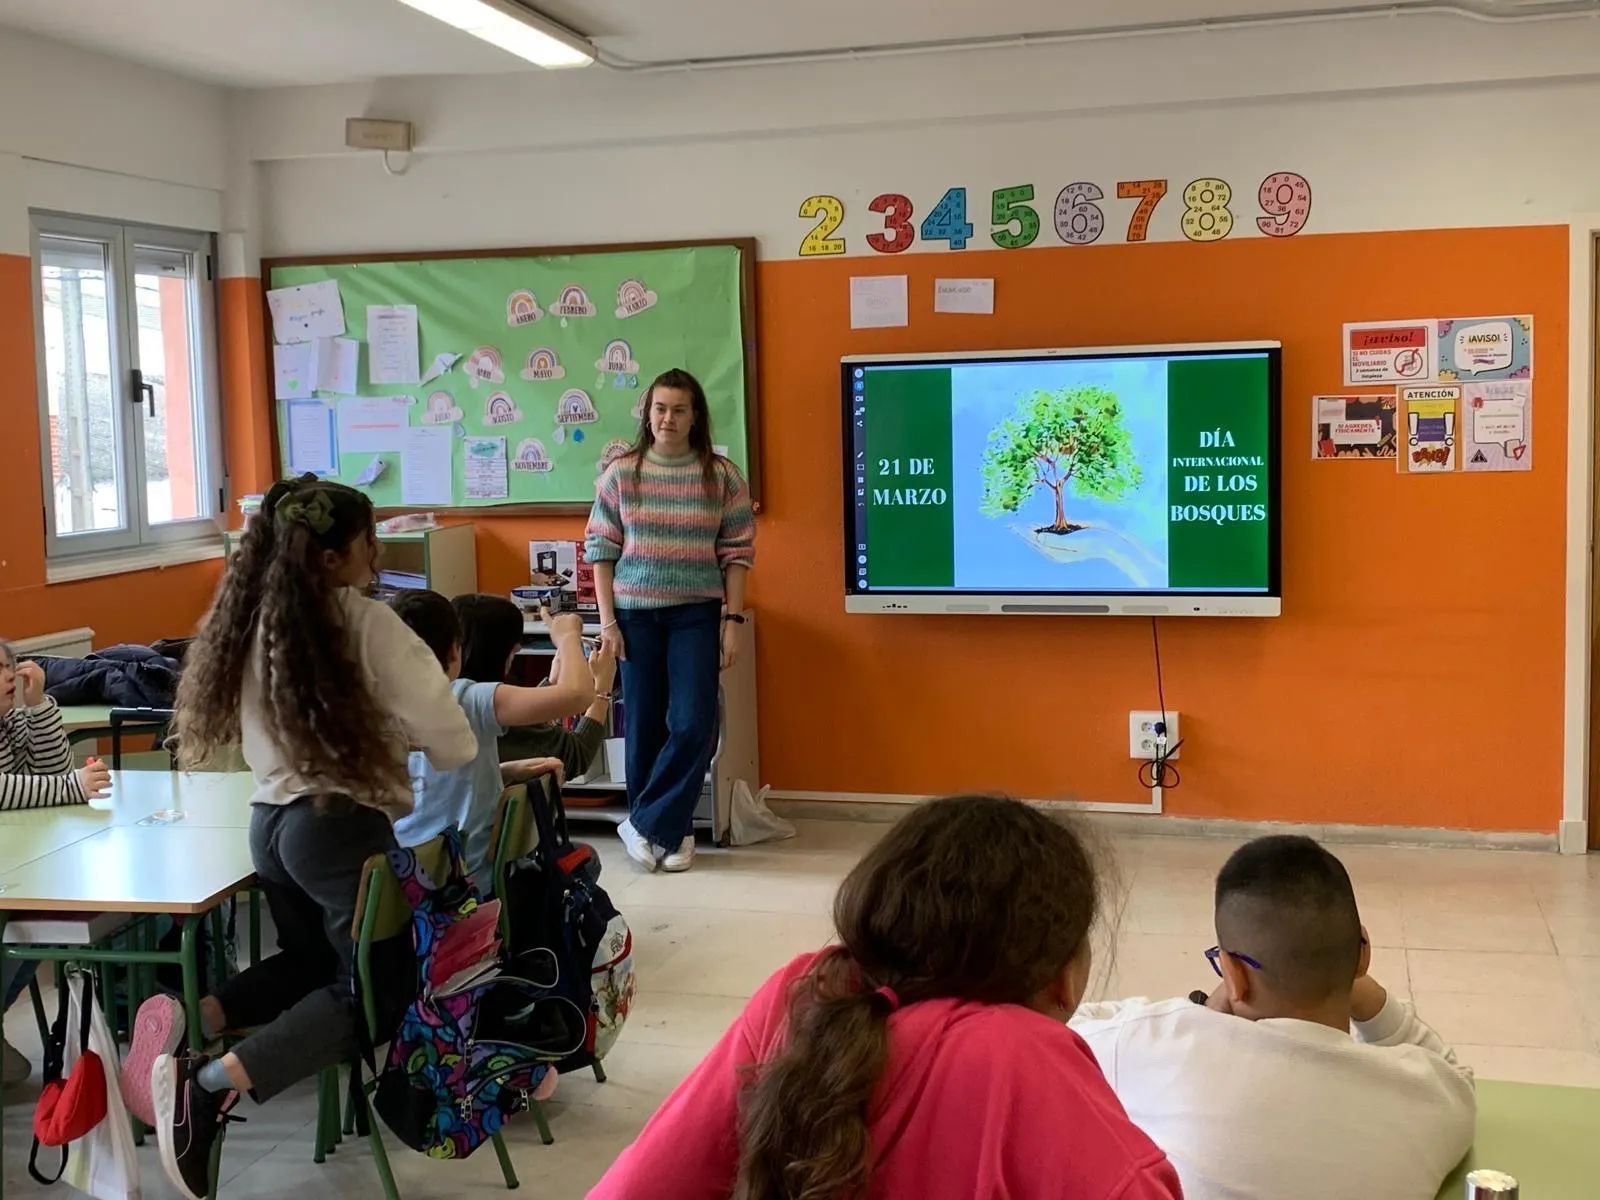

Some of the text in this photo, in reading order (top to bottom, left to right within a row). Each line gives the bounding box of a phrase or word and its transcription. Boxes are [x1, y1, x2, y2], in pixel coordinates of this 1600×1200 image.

[799, 171, 1312, 256] 2 3 4 5 6 7 8 9
[559, 305, 588, 315] FEBRERO
[534, 370, 552, 378] MAYO
[1408, 390, 1454, 398] ATENCIÓN
[558, 412, 595, 423] SEPTIEMBRE
[1200, 428, 1236, 448] DÍA
[879, 458, 934, 475] 21 DE
[1172, 456, 1264, 467] INTERNACIONAL
[1184, 475, 1257, 491] DE LOS
[873, 488, 946, 505] MARZO
[1171, 504, 1266, 525] BOSQUES
